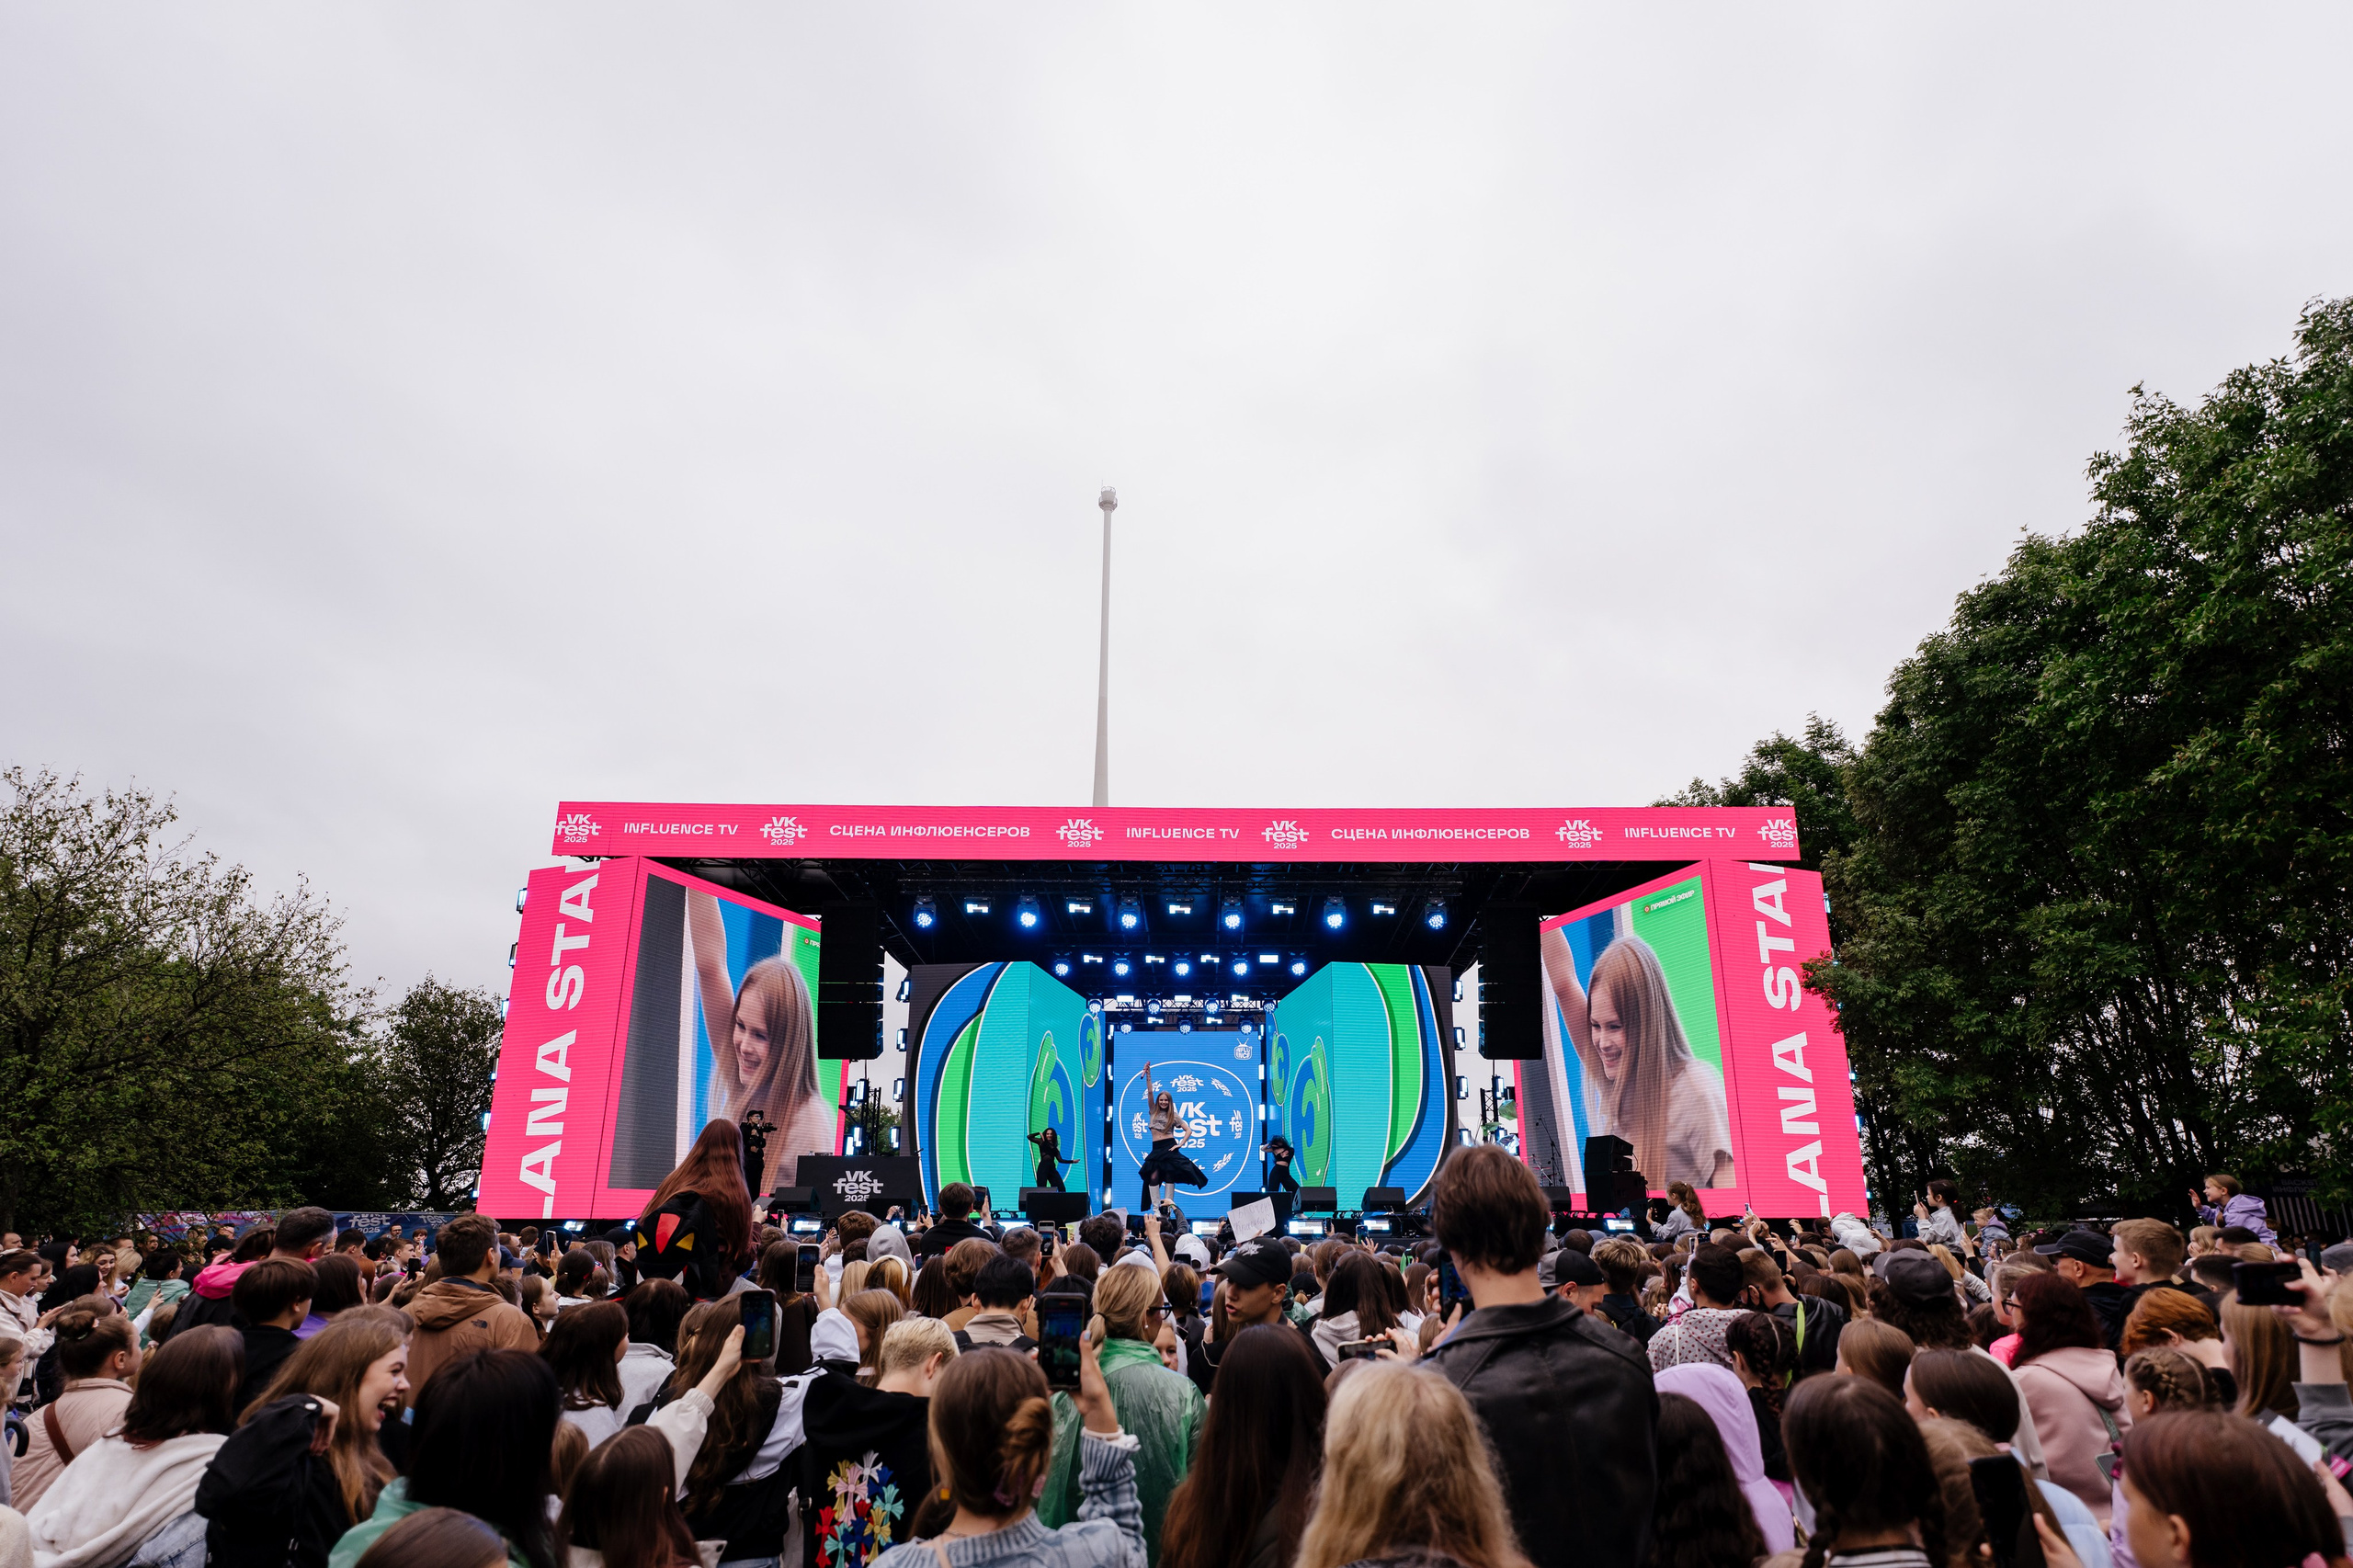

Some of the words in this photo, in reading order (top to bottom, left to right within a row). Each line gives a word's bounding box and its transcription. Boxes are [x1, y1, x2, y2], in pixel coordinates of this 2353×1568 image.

[566, 813, 593, 824] VK
[771, 816, 798, 827] VK
[1067, 819, 1093, 829] VK
[1564, 819, 1591, 830] VK
[1767, 819, 1793, 830] VK
[555, 821, 603, 835] fest
[623, 823, 714, 835] INFLUENCE
[718, 824, 739, 835] TV
[759, 823, 808, 838] fest
[829, 824, 886, 838] СЦЕНА
[890, 825, 1030, 838] ИНФЛЮЕНСЕРОВ
[1271, 820, 1298, 831] VK
[1055, 825, 1105, 840] fest
[1126, 827, 1215, 839] INFLUENCE
[1219, 828, 1240, 839] TV
[1260, 827, 1310, 842] fest
[1331, 828, 1388, 841] СЦЕНА
[1392, 828, 1530, 840] ИНФЛЮЕНСЕРОВ
[1554, 826, 1604, 841] fest
[1624, 827, 1712, 838] INFLUENCE
[1715, 827, 1736, 838] TV
[1170, 1077, 1204, 1088] fest
[1173, 1114, 1222, 1138] est
[845, 1170, 873, 1183] VK
[832, 1177, 884, 1195] fest
[348, 1213, 391, 1228] fest
